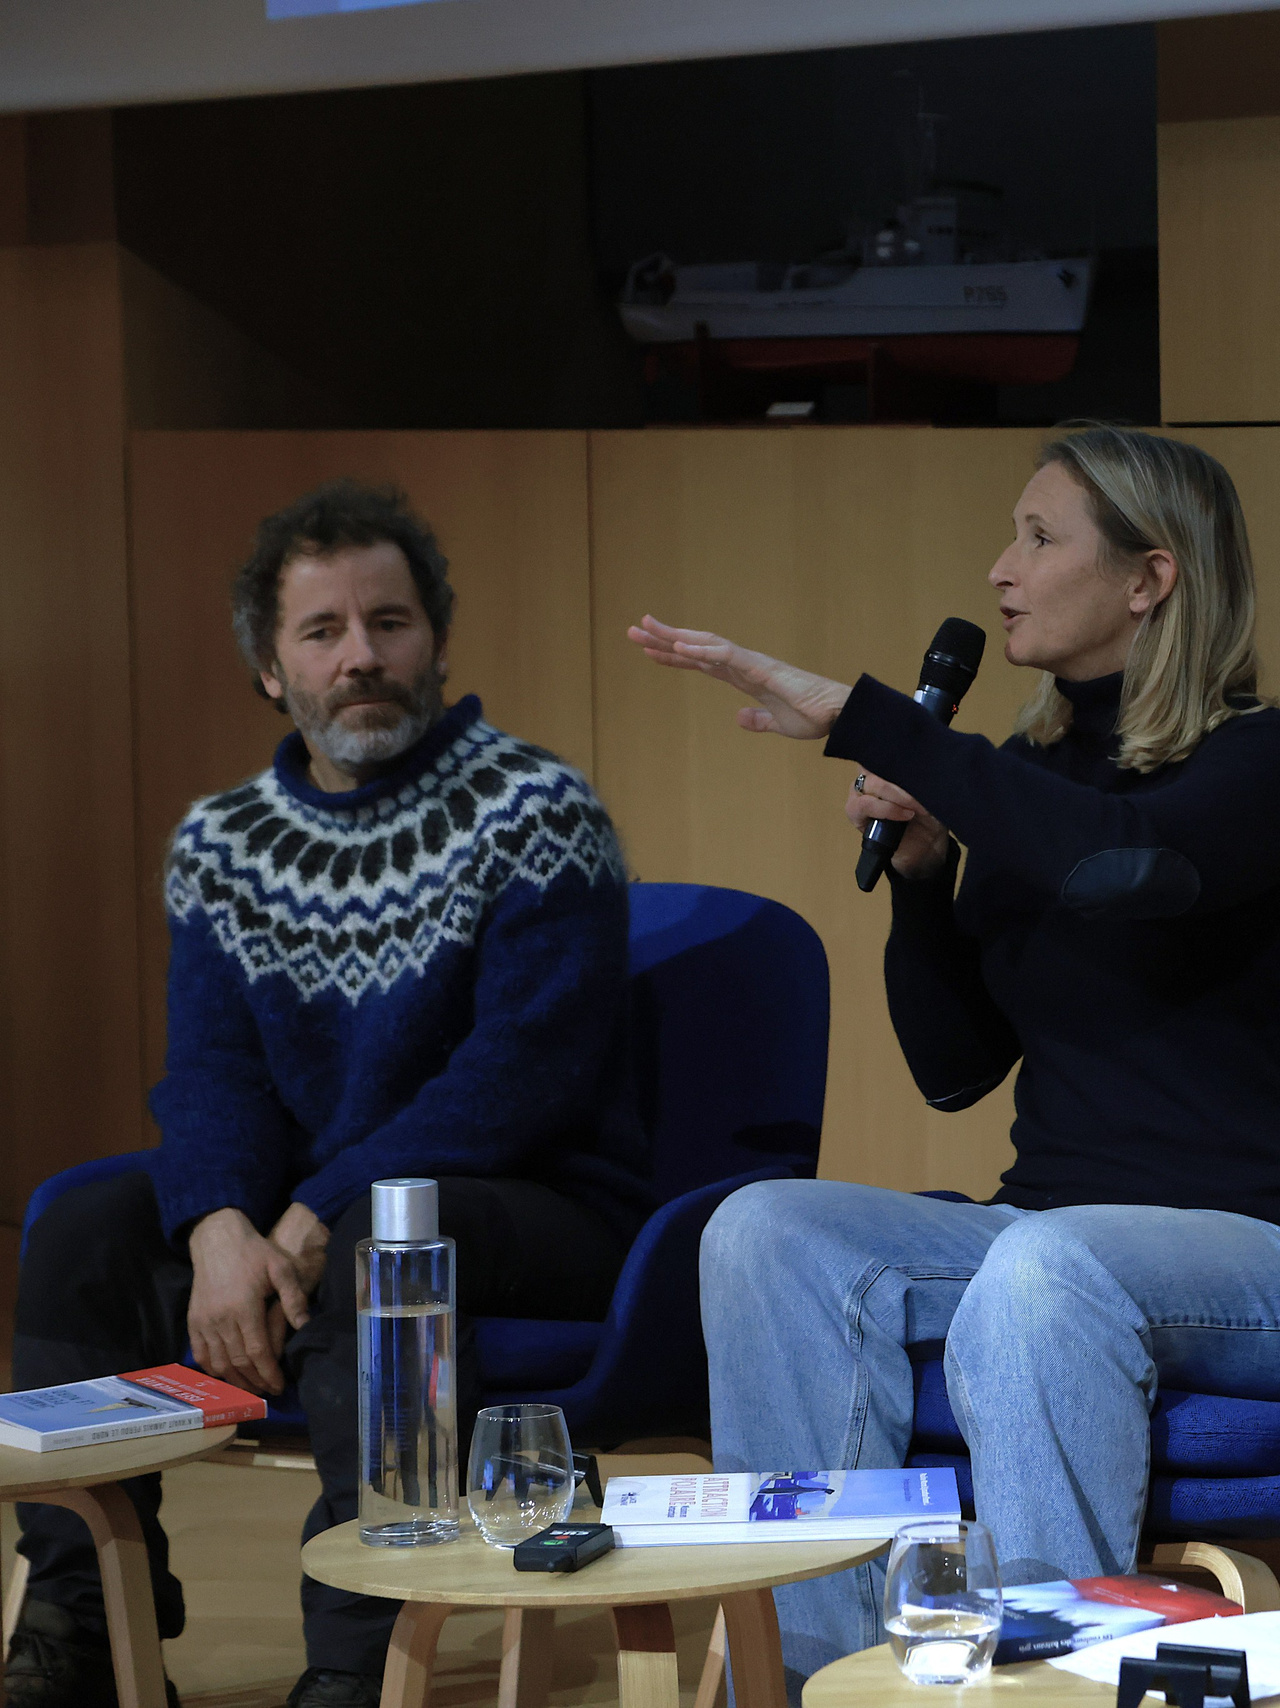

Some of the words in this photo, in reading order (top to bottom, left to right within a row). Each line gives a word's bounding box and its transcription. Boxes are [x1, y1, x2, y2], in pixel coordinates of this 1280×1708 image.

[120, 1426, 141, 1435] PERDU
[91, 1431, 109, 1440] NORD
[669, 1477, 697, 1505] POLAIRE
[700, 1477, 729, 1517] ATTRACTION
[1033, 1641, 1059, 1650] bateaux
[1060, 1639, 1072, 1647] des
